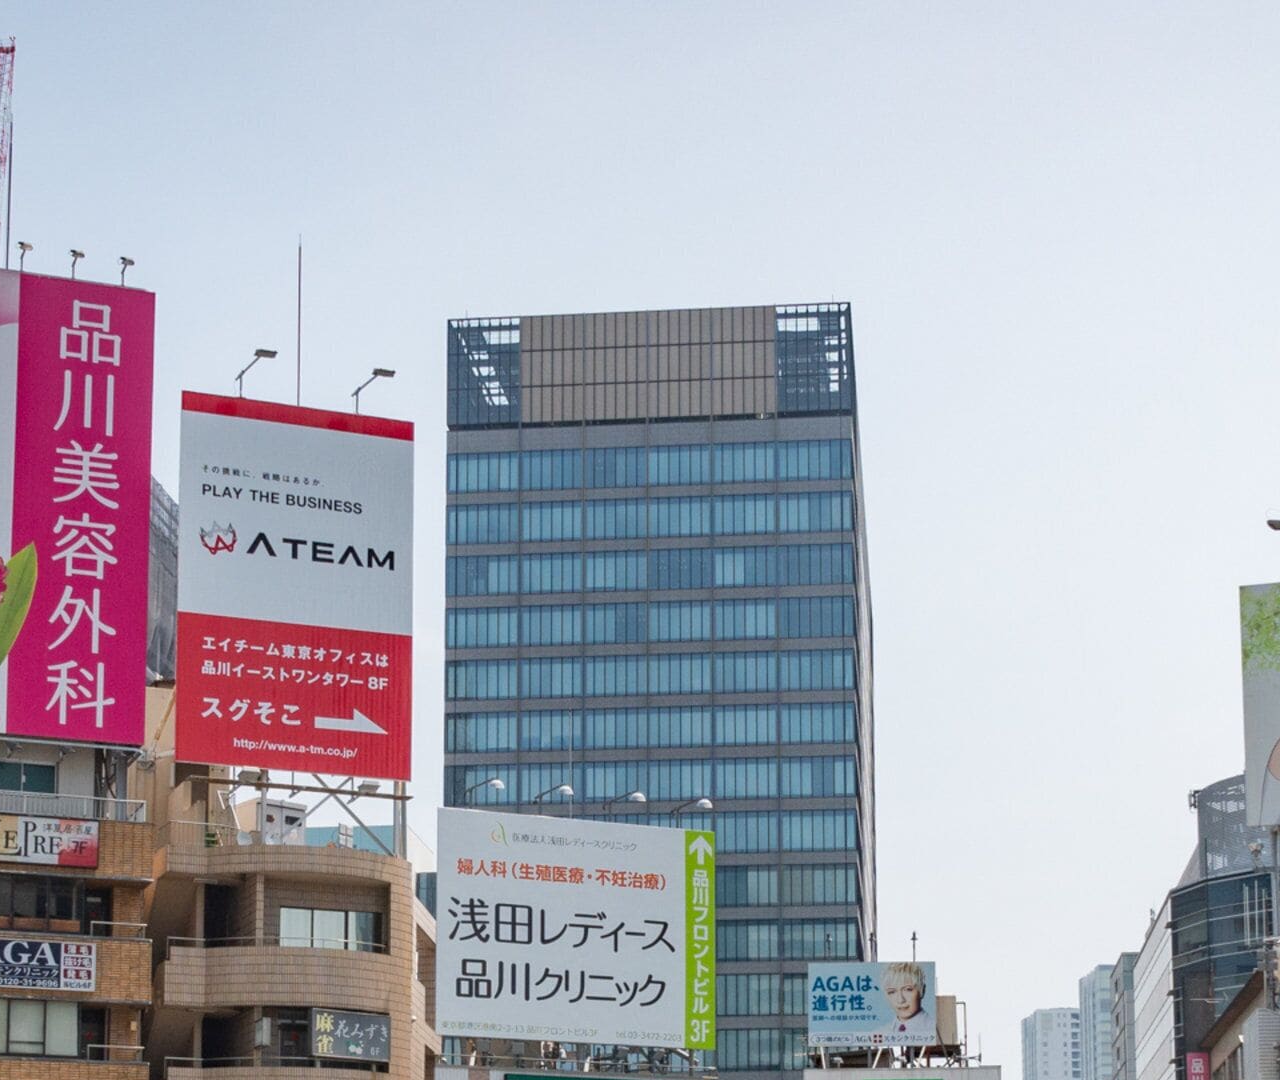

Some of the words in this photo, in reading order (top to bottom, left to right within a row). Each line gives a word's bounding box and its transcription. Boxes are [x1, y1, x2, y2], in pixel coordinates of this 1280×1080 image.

[45, 299, 122, 729] 品川美容外科
[201, 483, 243, 500] PLAY
[249, 488, 280, 505] THE
[285, 493, 364, 516] BUSINESS
[245, 531, 396, 572] ATEAM
[201, 636, 390, 669] エイチーム東京オフィスは
[201, 659, 364, 688] 品川イーストワンタワー
[367, 675, 390, 692] 8F
[200, 696, 304, 727] スグそこ
[233, 737, 359, 760] http://www.a-tm.co.jp/
[447, 895, 677, 954] 浅田レディース
[691, 869, 711, 1015] 品川フロントビル
[455, 957, 667, 1008] 品川クリニック
[811, 975, 881, 993] AGAは、
[811, 994, 874, 1013] 進行性。
[315, 1012, 335, 1055] 麻雀
[334, 1020, 390, 1043] 花みずき
[690, 1018, 711, 1044] 3F
